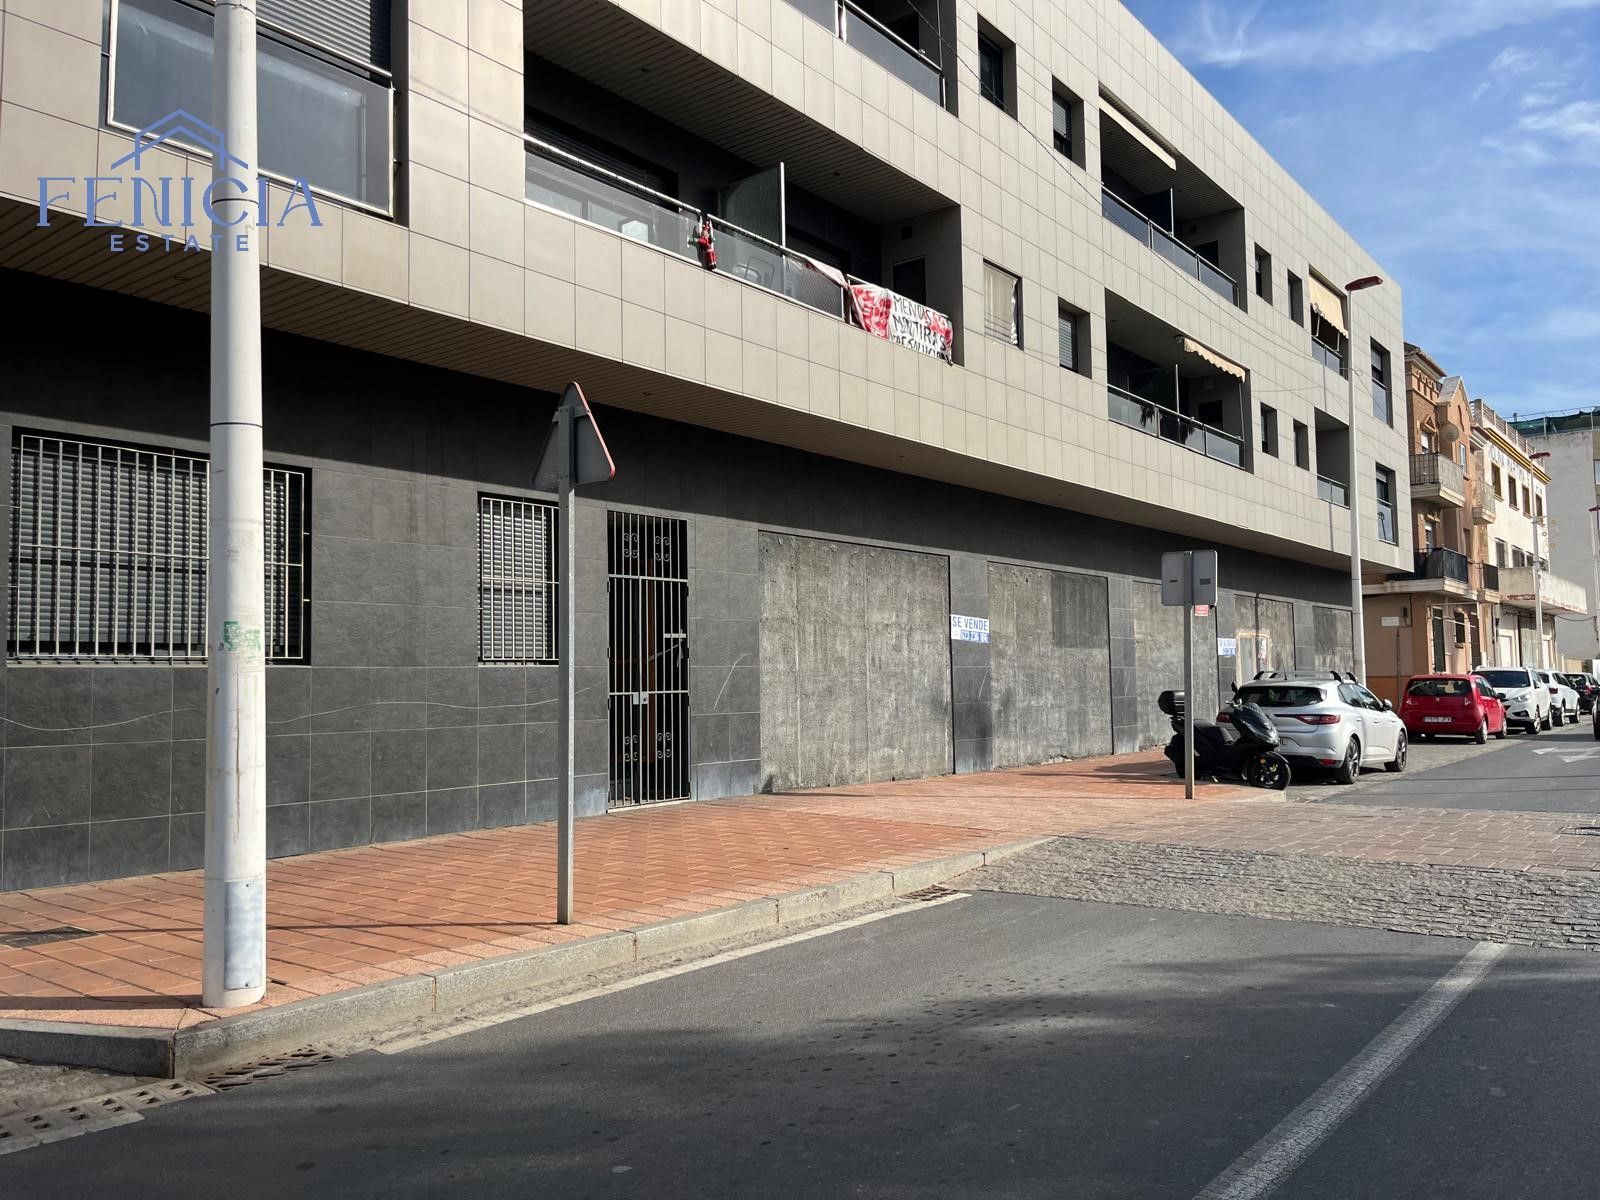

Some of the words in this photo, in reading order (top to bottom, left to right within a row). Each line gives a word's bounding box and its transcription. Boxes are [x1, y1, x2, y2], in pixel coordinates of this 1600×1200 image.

[893, 294, 932, 326] MENOS
[952, 616, 962, 628] SE
[964, 617, 988, 631] VENDE
